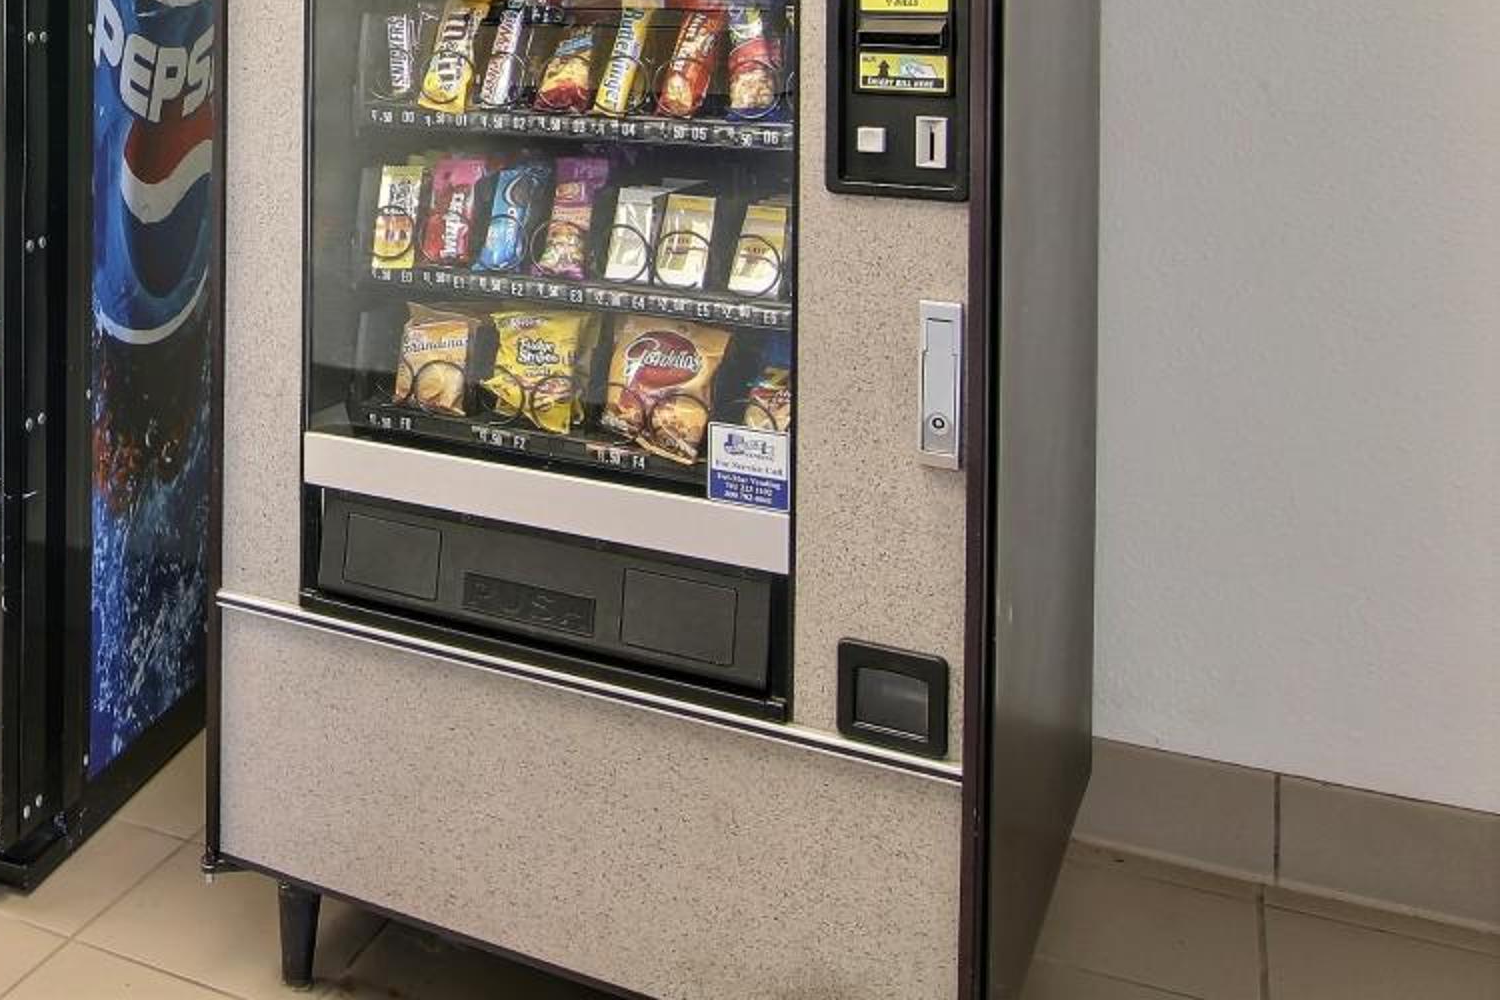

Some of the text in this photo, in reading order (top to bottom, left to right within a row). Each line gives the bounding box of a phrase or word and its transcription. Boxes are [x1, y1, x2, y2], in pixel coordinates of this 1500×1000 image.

[388, 12, 410, 92] SNICKERS
[604, 9, 644, 107] Butterfinger
[624, 337, 701, 380] Gardetto's
[513, 435, 526, 448] F2
[632, 456, 645, 469] F4
